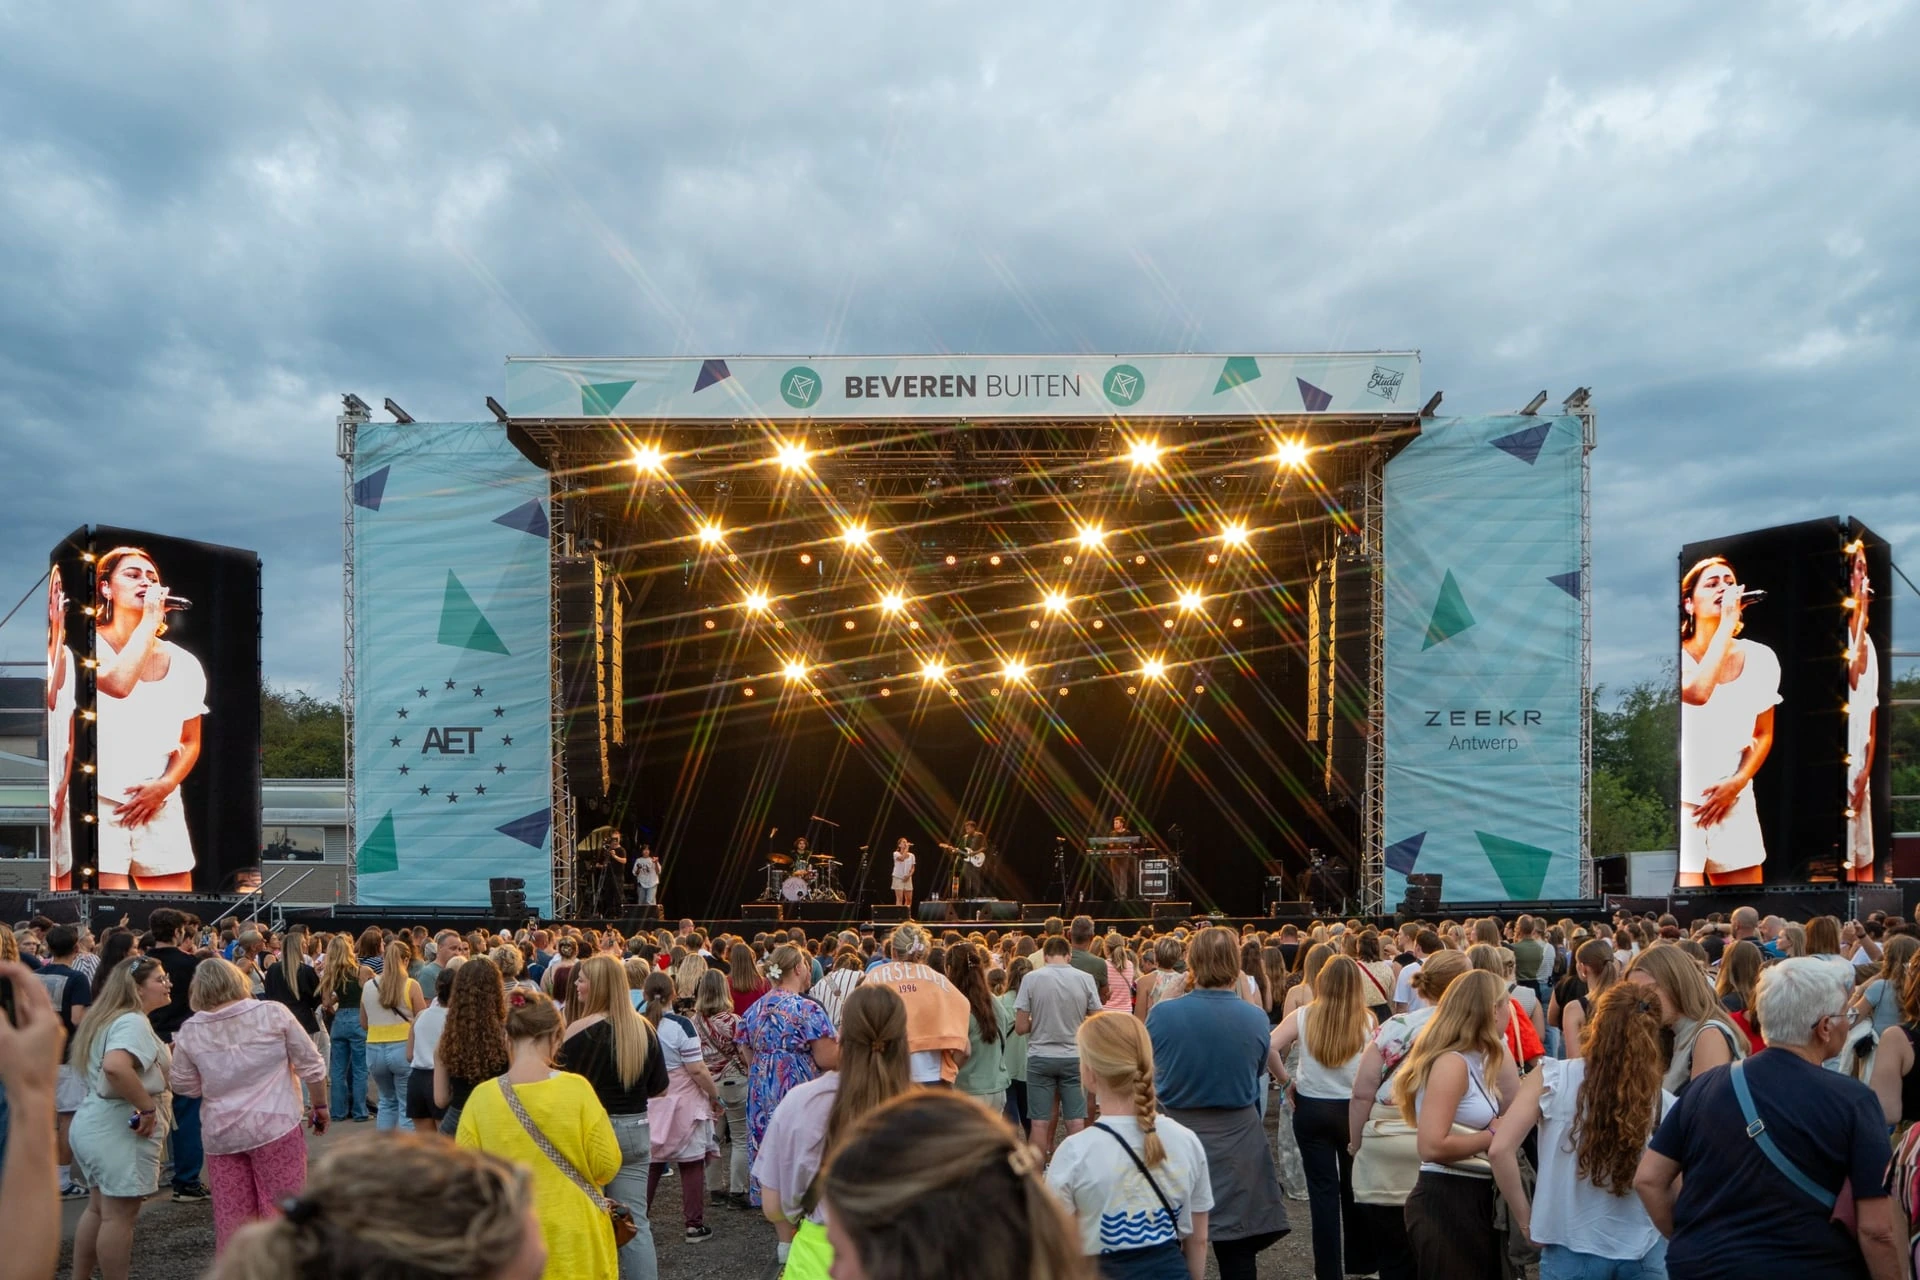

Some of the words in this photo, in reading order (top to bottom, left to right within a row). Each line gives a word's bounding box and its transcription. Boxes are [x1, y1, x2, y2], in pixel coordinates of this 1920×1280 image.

[845, 375, 977, 399] BEVEREN
[986, 374, 1081, 398] BUITEN
[1367, 372, 1401, 389] Studio
[1424, 710, 1542, 727] ZEEKR
[421, 727, 483, 754] AET
[1448, 735, 1518, 753] Antwerp
[898, 984, 917, 993] 1996
